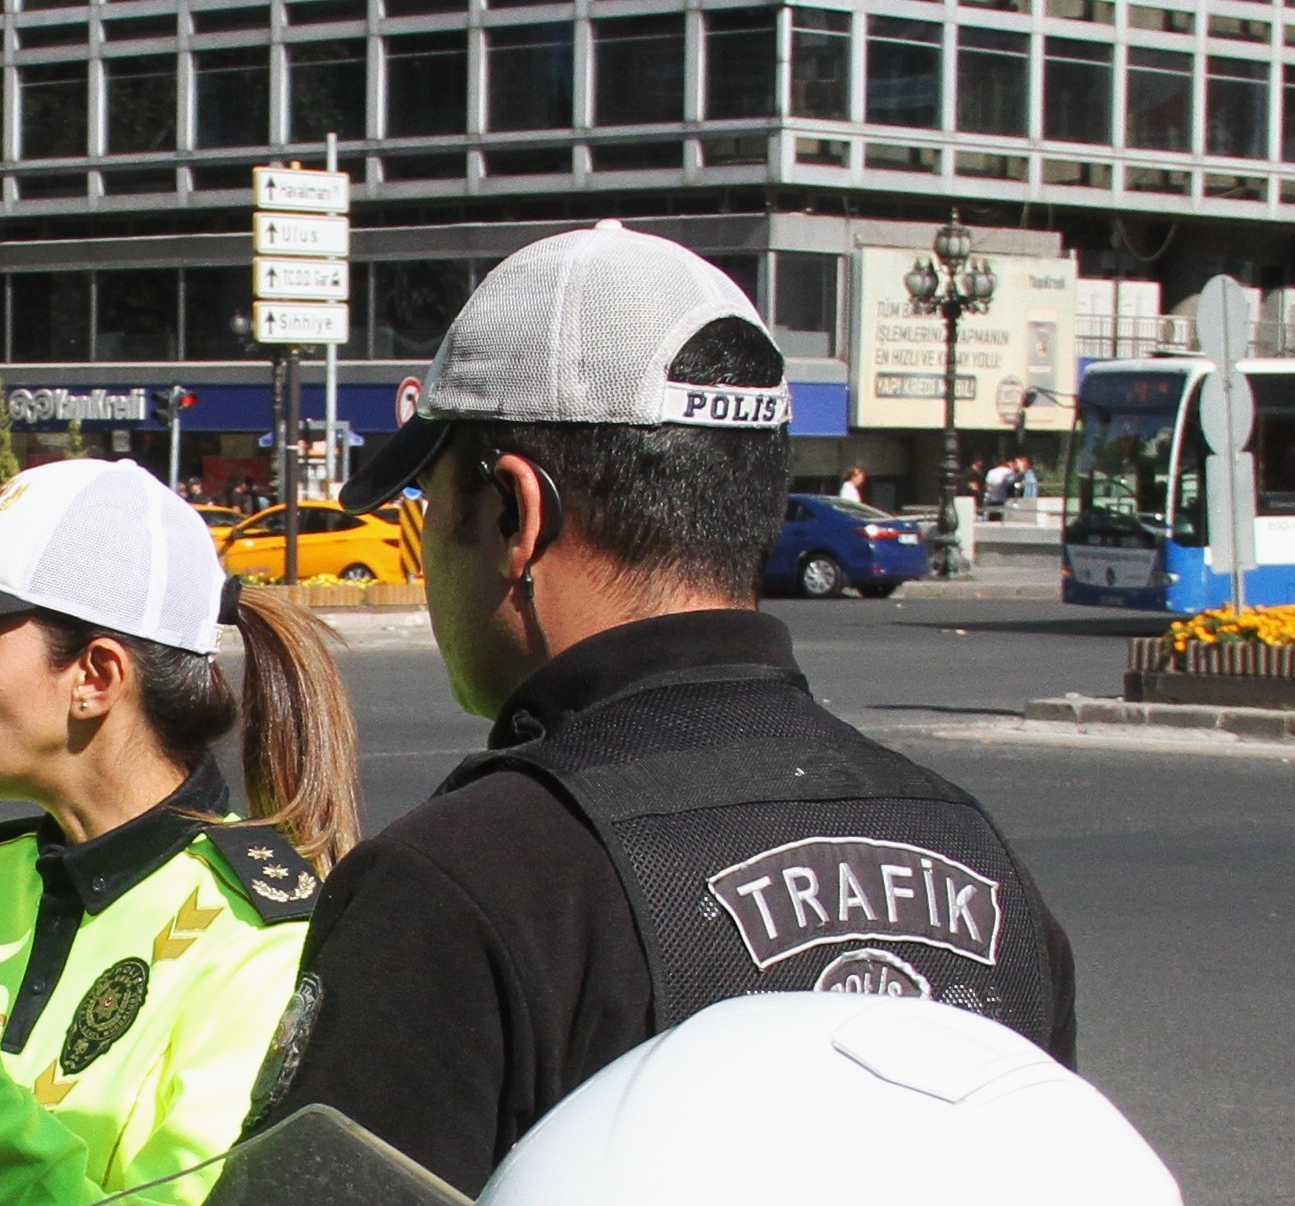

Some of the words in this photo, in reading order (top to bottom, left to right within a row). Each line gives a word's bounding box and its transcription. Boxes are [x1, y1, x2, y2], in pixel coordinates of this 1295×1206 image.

[282, 226, 318, 243] Ulus
[683, 394, 777, 424] POLIS
[737, 858, 984, 942] TRAFİK
